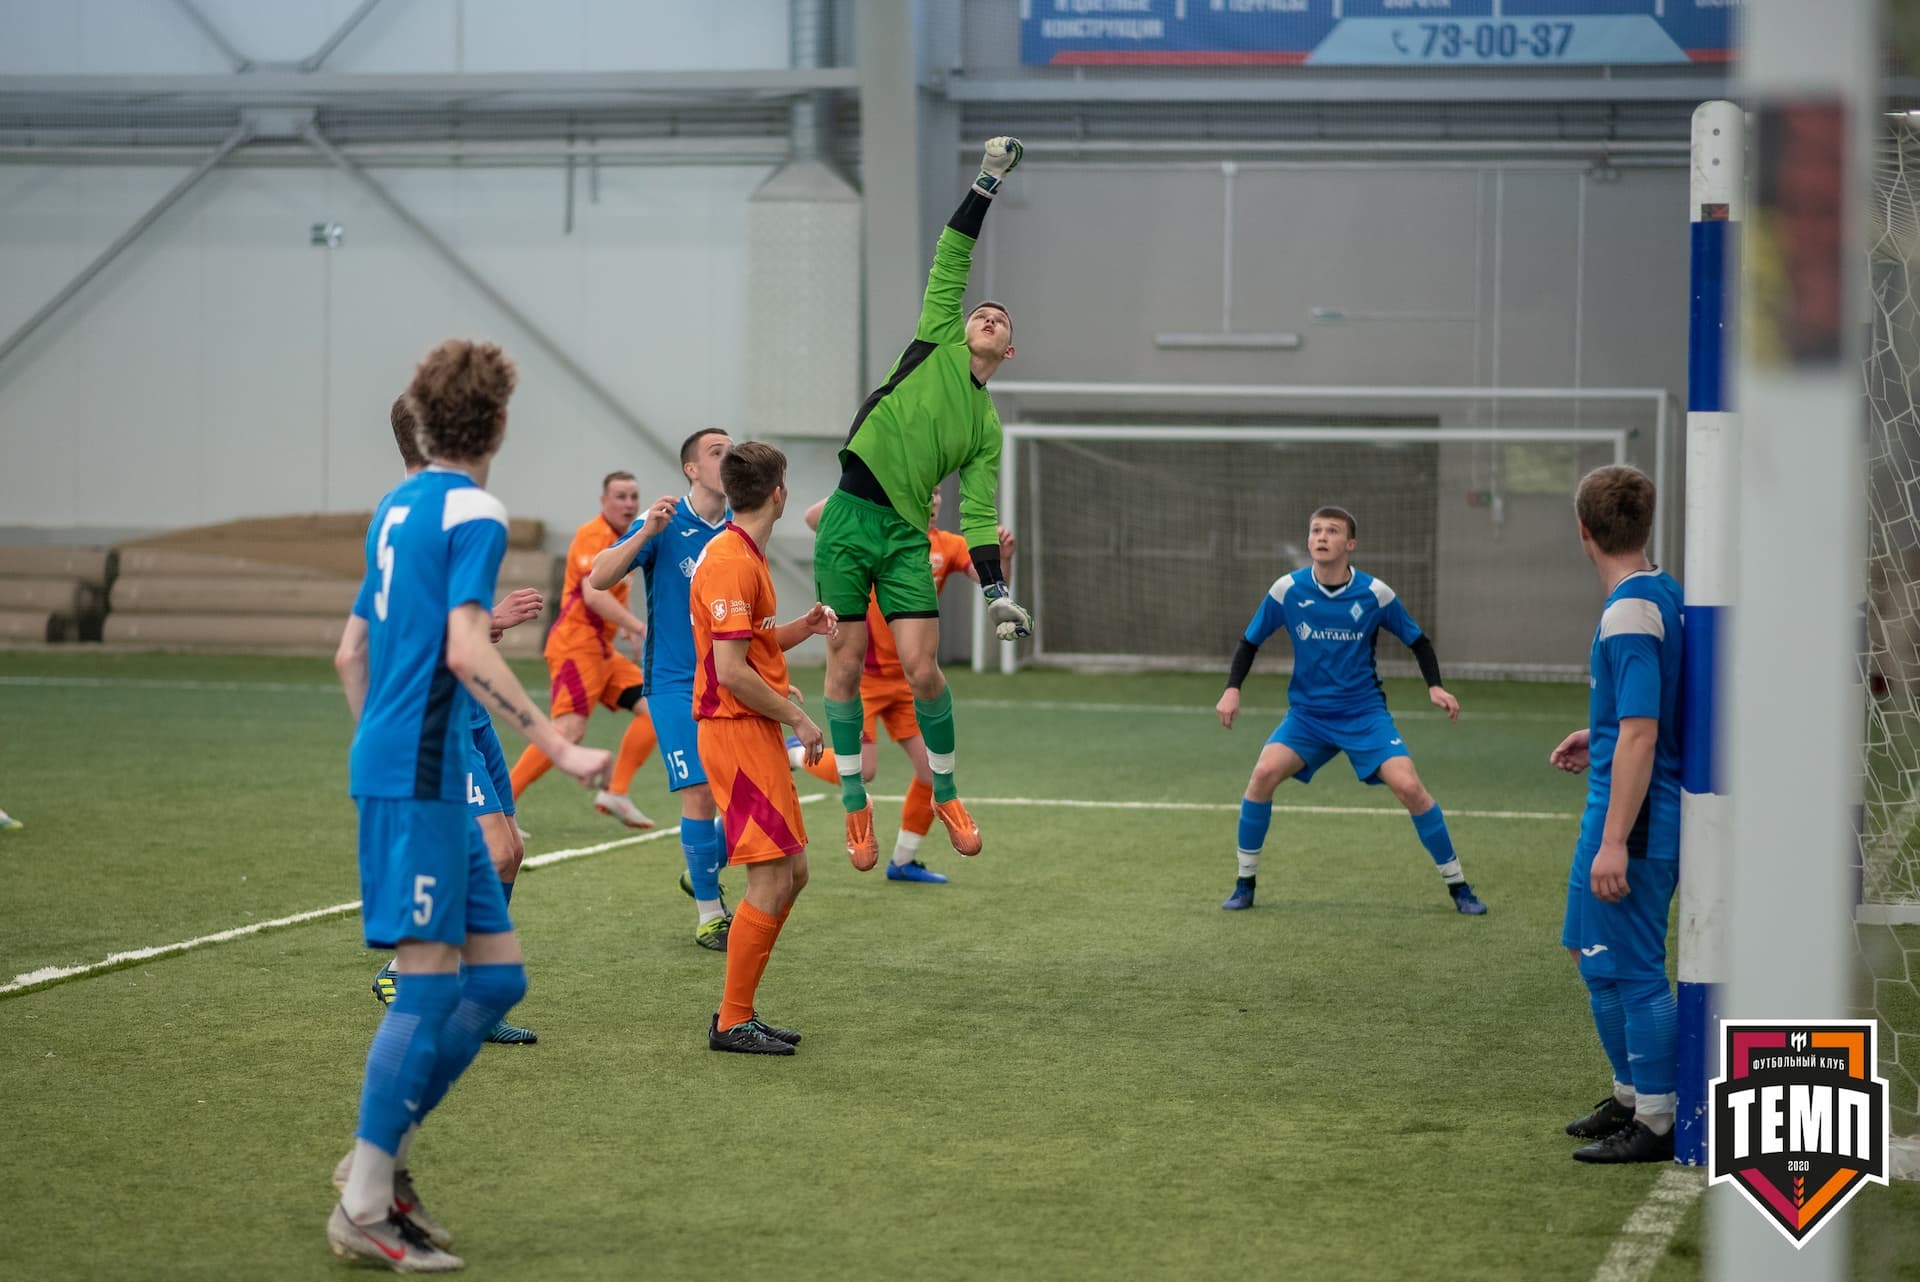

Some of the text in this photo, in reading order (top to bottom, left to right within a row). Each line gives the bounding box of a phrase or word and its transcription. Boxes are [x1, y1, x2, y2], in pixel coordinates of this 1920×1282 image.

[1418, 22, 1575, 58] 73-00-37
[374, 505, 411, 622] 5
[667, 749, 689, 782] 15
[413, 874, 437, 926] 5
